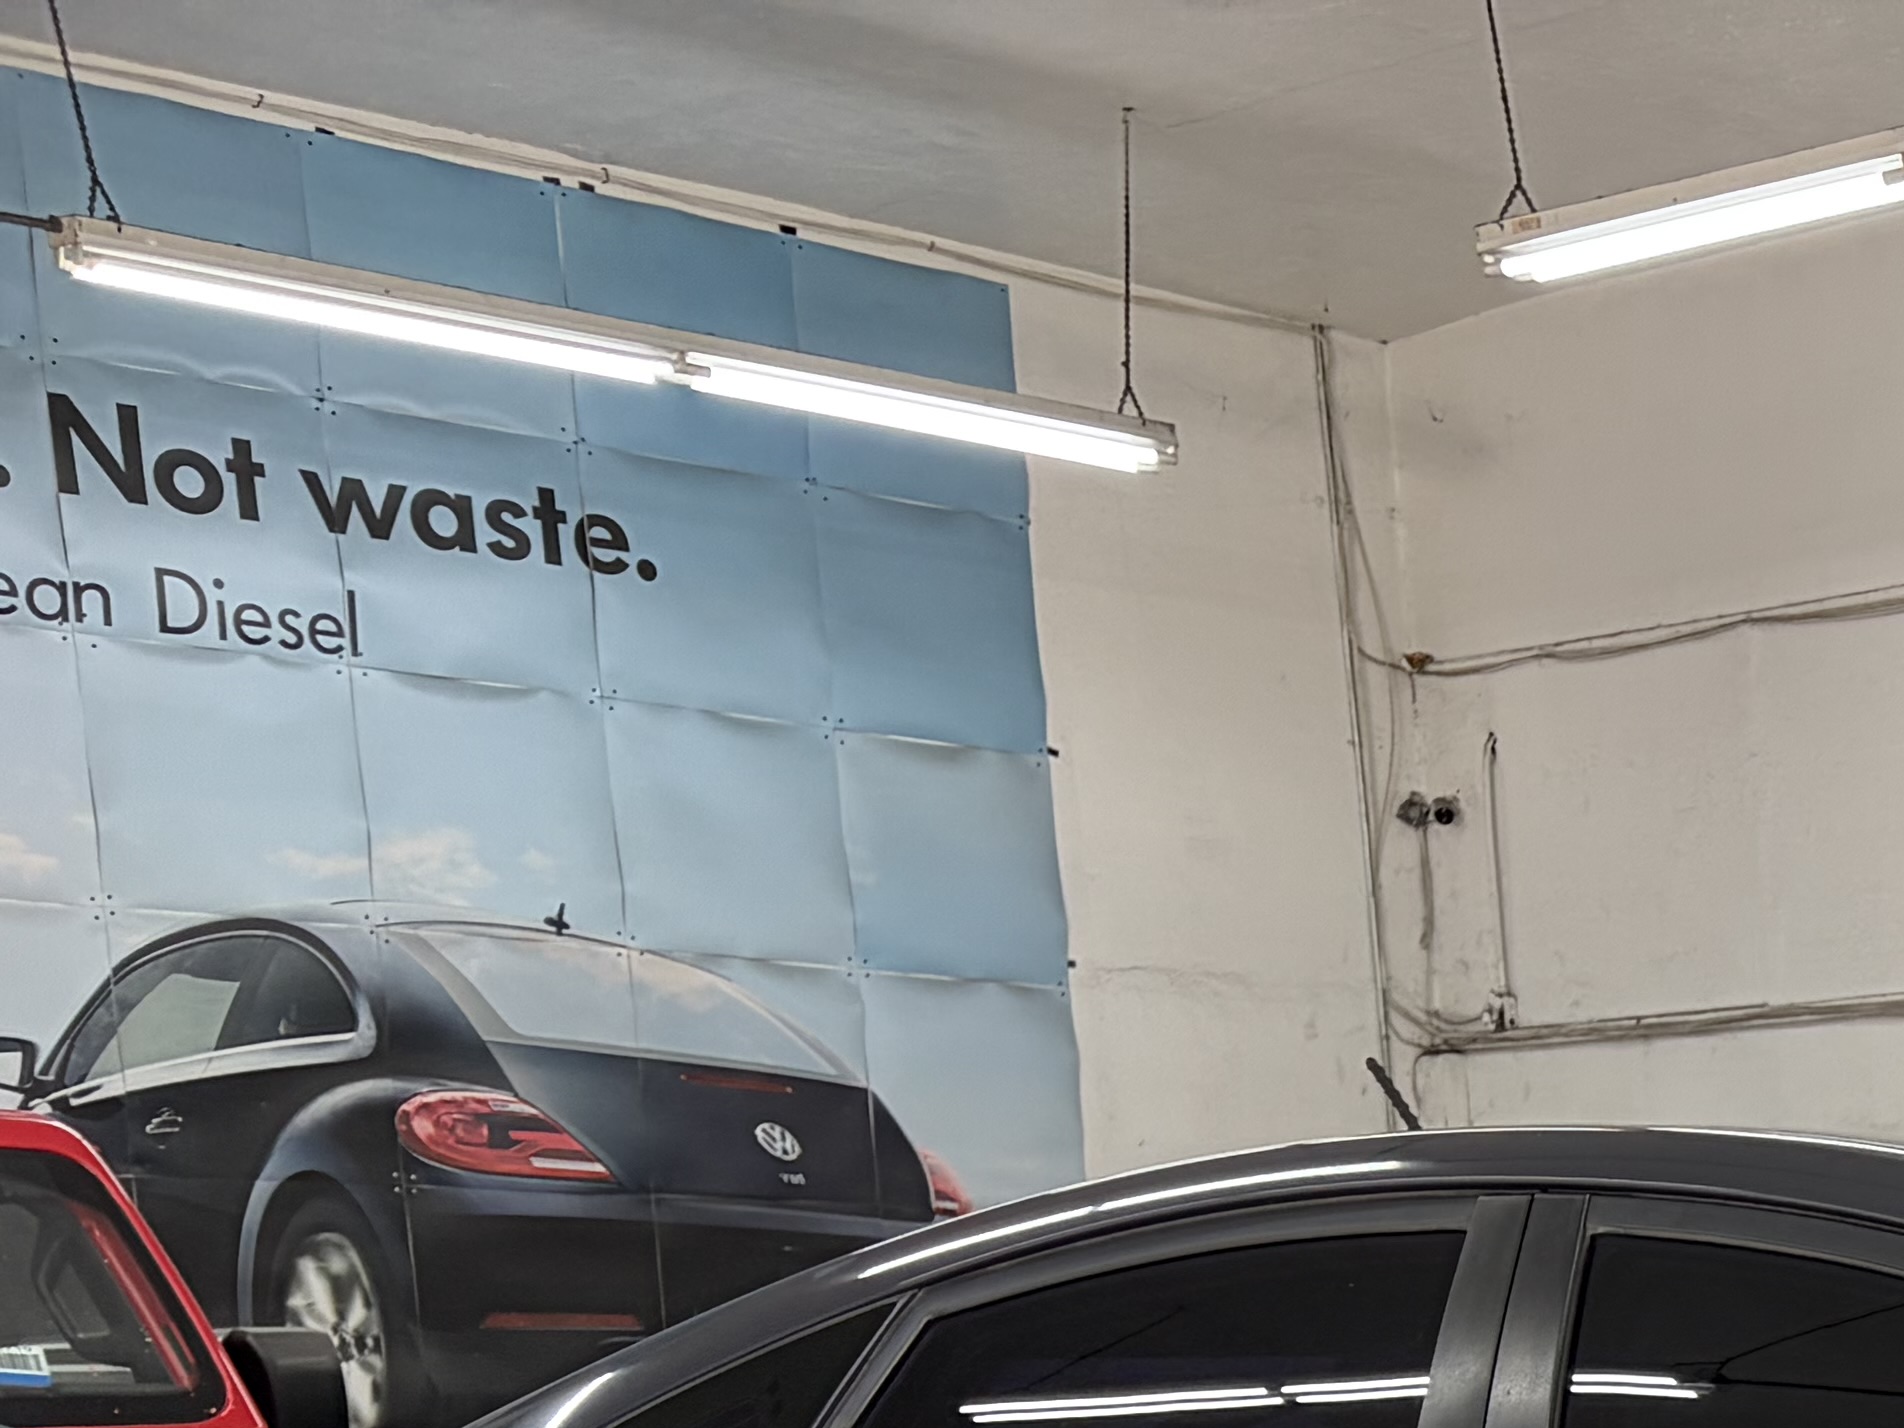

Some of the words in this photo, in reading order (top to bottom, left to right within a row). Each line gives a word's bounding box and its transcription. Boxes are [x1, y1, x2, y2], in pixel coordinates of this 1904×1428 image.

[46, 390, 266, 523] Not
[298, 468, 658, 582] waste.
[153, 566, 362, 657] Diesel
